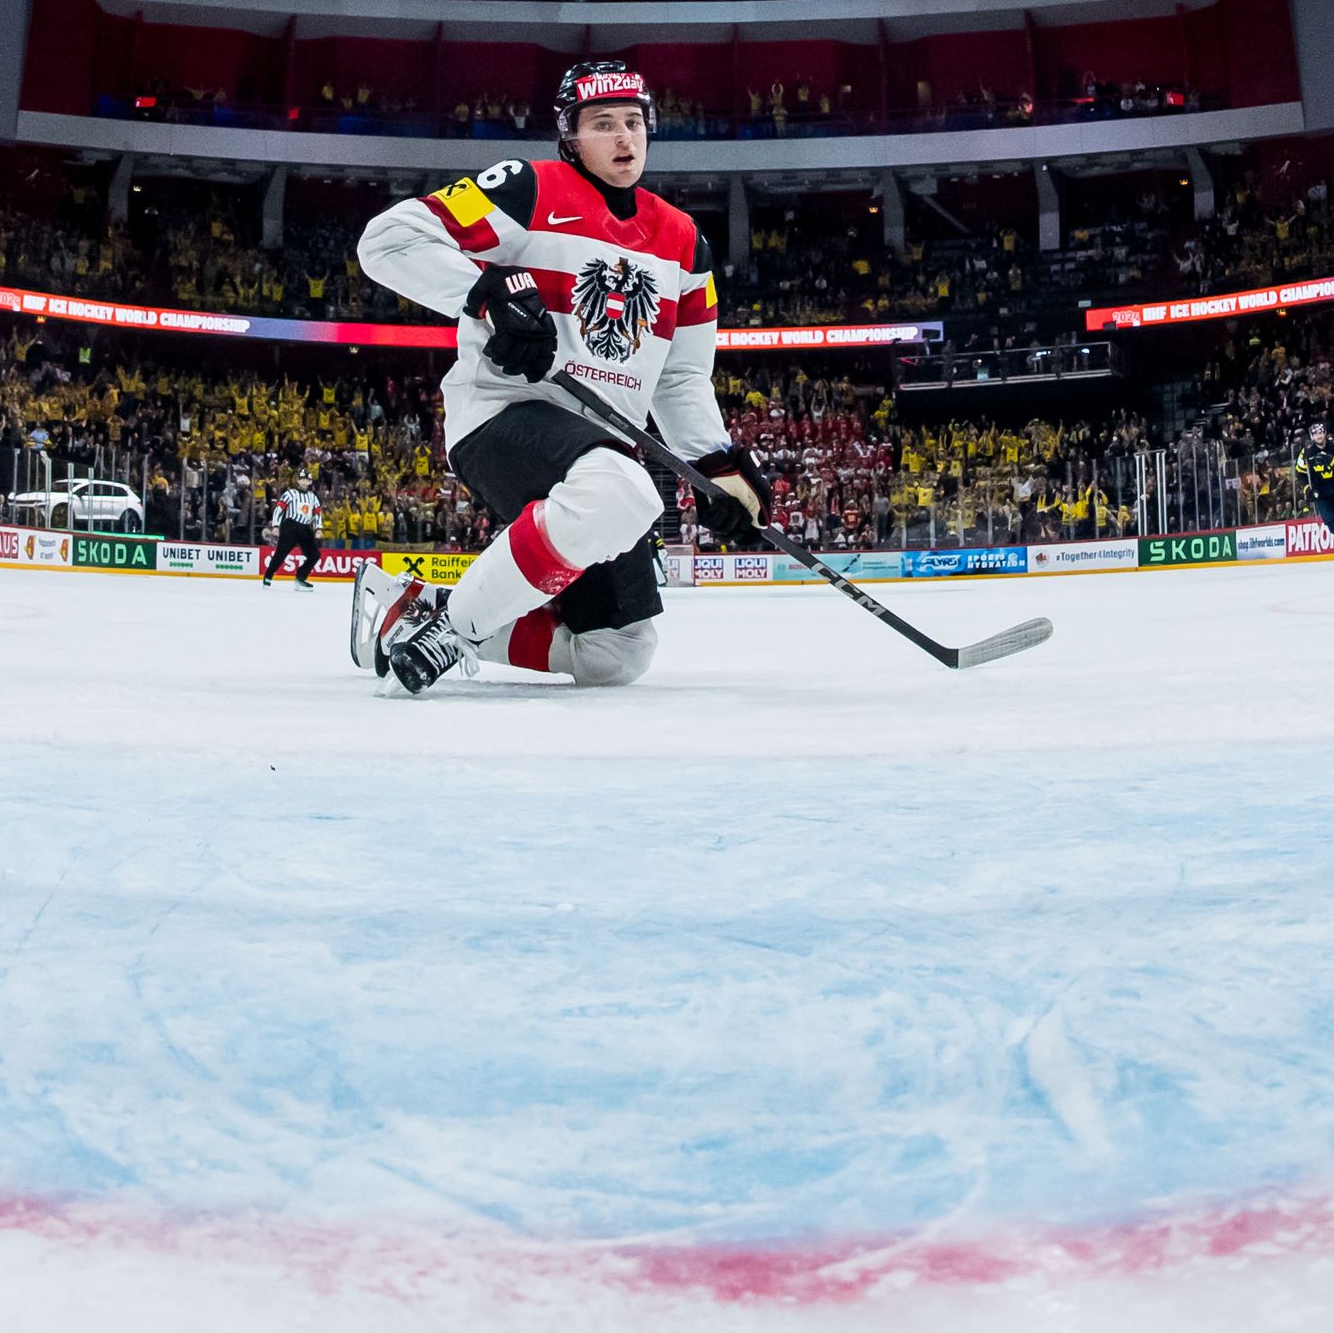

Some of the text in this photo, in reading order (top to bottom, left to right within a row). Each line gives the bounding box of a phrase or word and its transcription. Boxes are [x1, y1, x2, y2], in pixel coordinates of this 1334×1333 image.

[1170, 302, 1190, 319] ICE
[1190, 296, 1237, 317] HOCKEY
[1237, 291, 1278, 311] WORLD
[68, 301, 115, 321] HOCKEY
[115, 308, 158, 326] WORLD
[159, 310, 251, 334] CHAMPIONSHIP
[730, 331, 780, 346] HOCKEY
[781, 330, 825, 345] WORLD
[827, 326, 919, 343] CHAMPIONSHIP
[564, 359, 642, 392] ÖSTERREICH
[162, 547, 252, 562] UNIBET UNIBET
[431, 557, 476, 568] Raiffei
[735, 558, 767, 568] LIQUI
[431, 569, 462, 579] Bank
[735, 569, 767, 579] MOLY
